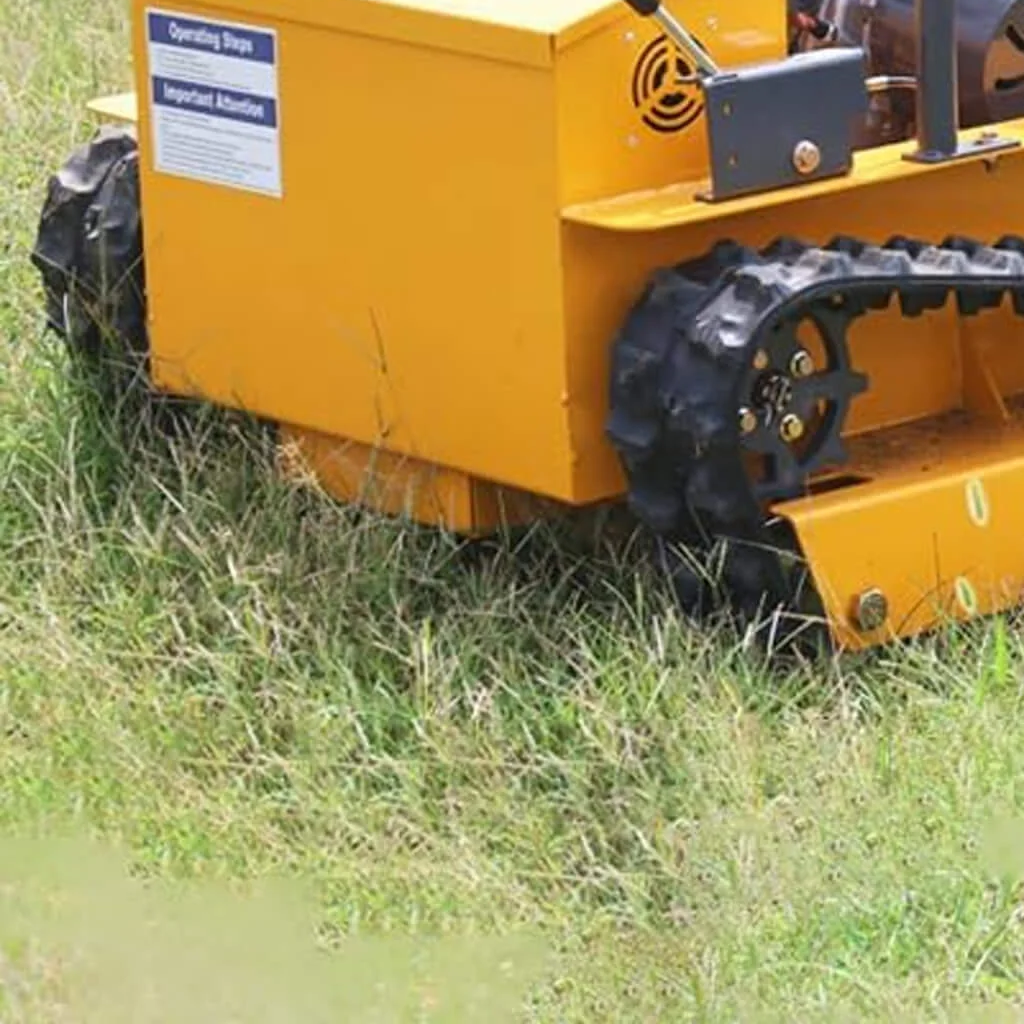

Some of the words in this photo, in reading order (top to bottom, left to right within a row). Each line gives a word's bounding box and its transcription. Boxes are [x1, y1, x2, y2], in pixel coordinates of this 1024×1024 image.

[168, 21, 219, 50] Operating
[223, 31, 253, 54] Steps
[163, 82, 213, 108] Important
[215, 91, 264, 118] Attention
